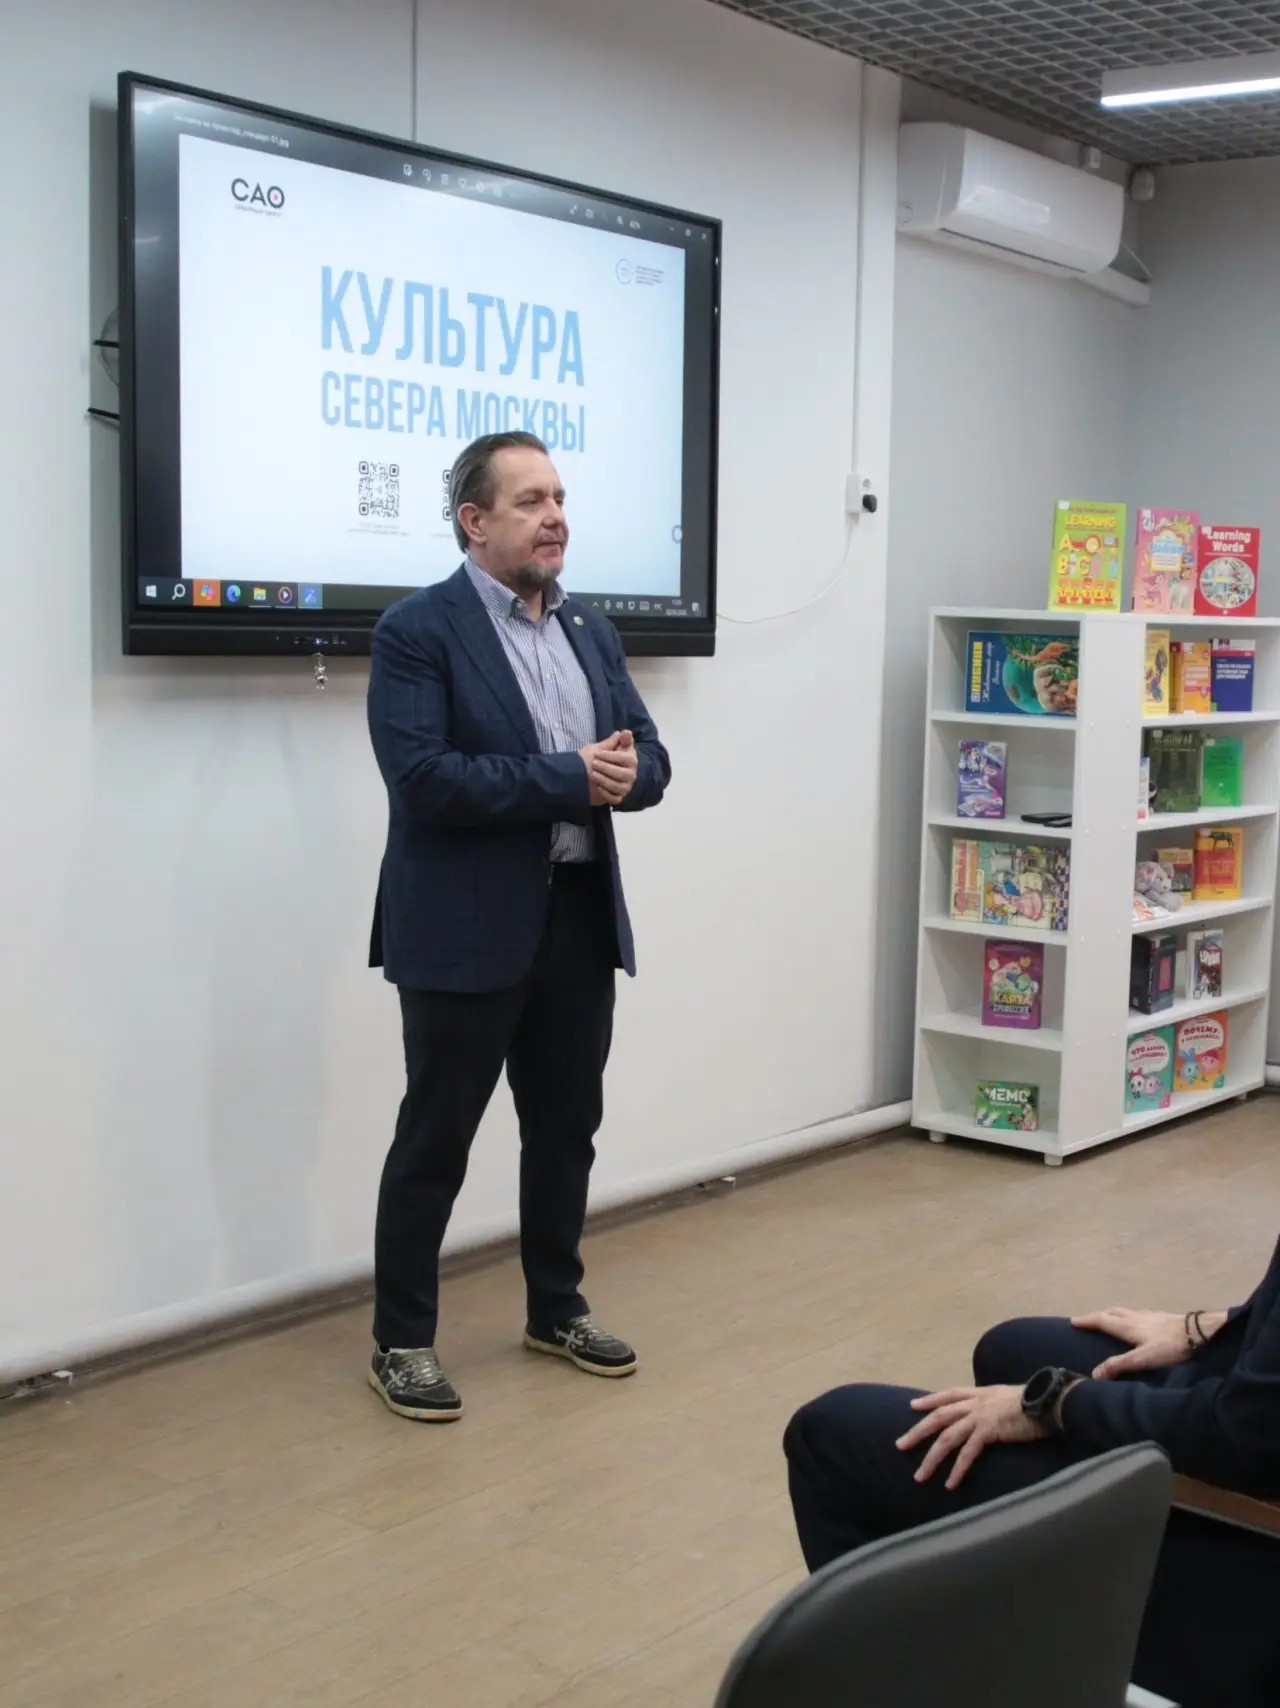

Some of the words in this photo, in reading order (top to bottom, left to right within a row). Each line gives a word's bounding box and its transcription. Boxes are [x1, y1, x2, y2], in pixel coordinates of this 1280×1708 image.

[231, 178, 285, 209] САО
[321, 265, 585, 387] КУЛЬТУРА
[321, 370, 446, 438] СЕВЕРА
[456, 388, 585, 453] МОСКВЫ
[1206, 529, 1251, 542] Learning
[1212, 541, 1245, 553] Words
